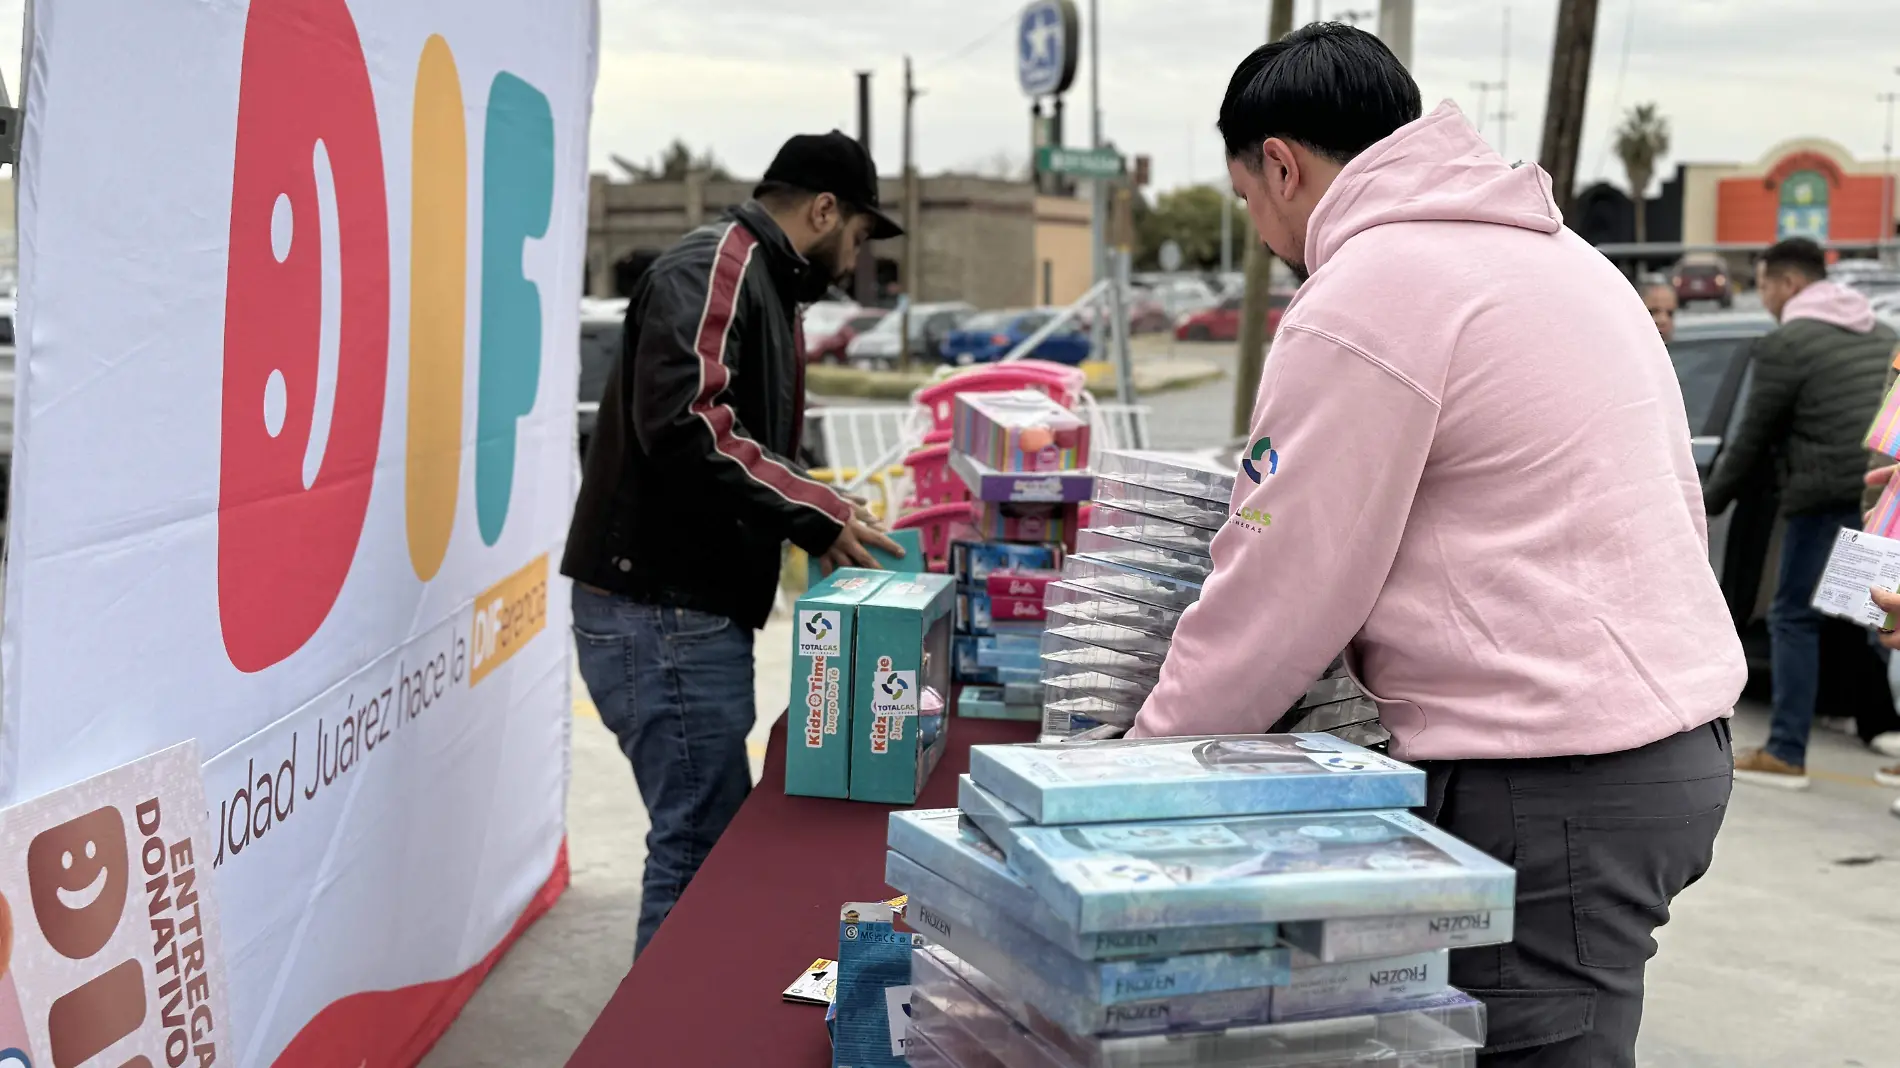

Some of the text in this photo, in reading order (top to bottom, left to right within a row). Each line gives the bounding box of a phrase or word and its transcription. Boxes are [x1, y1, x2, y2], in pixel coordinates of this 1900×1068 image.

[217, 0, 555, 673] DIF
[800, 643, 838, 651] TOTALGAS
[809, 655, 824, 692] Time
[304, 693, 393, 801] Juárez
[396, 651, 446, 730] hace
[449, 625, 466, 688] la
[826, 669, 838, 733] Juego De Té
[877, 703, 916, 711] TOTALGAS
[807, 709, 821, 746] Kidz
[872, 715, 887, 751] Kidz
[136, 796, 189, 1068] DONATIVO
[919, 905, 952, 938] FROZEN
[1428, 911, 1491, 936] FROZEN
[169, 836, 217, 1068] ENTREGA
[1097, 933, 1159, 950] FROZEN
[1115, 973, 1176, 996] FROZEN
[1369, 963, 1428, 989] FROZEN
[1106, 1005, 1171, 1025] FROZEN
